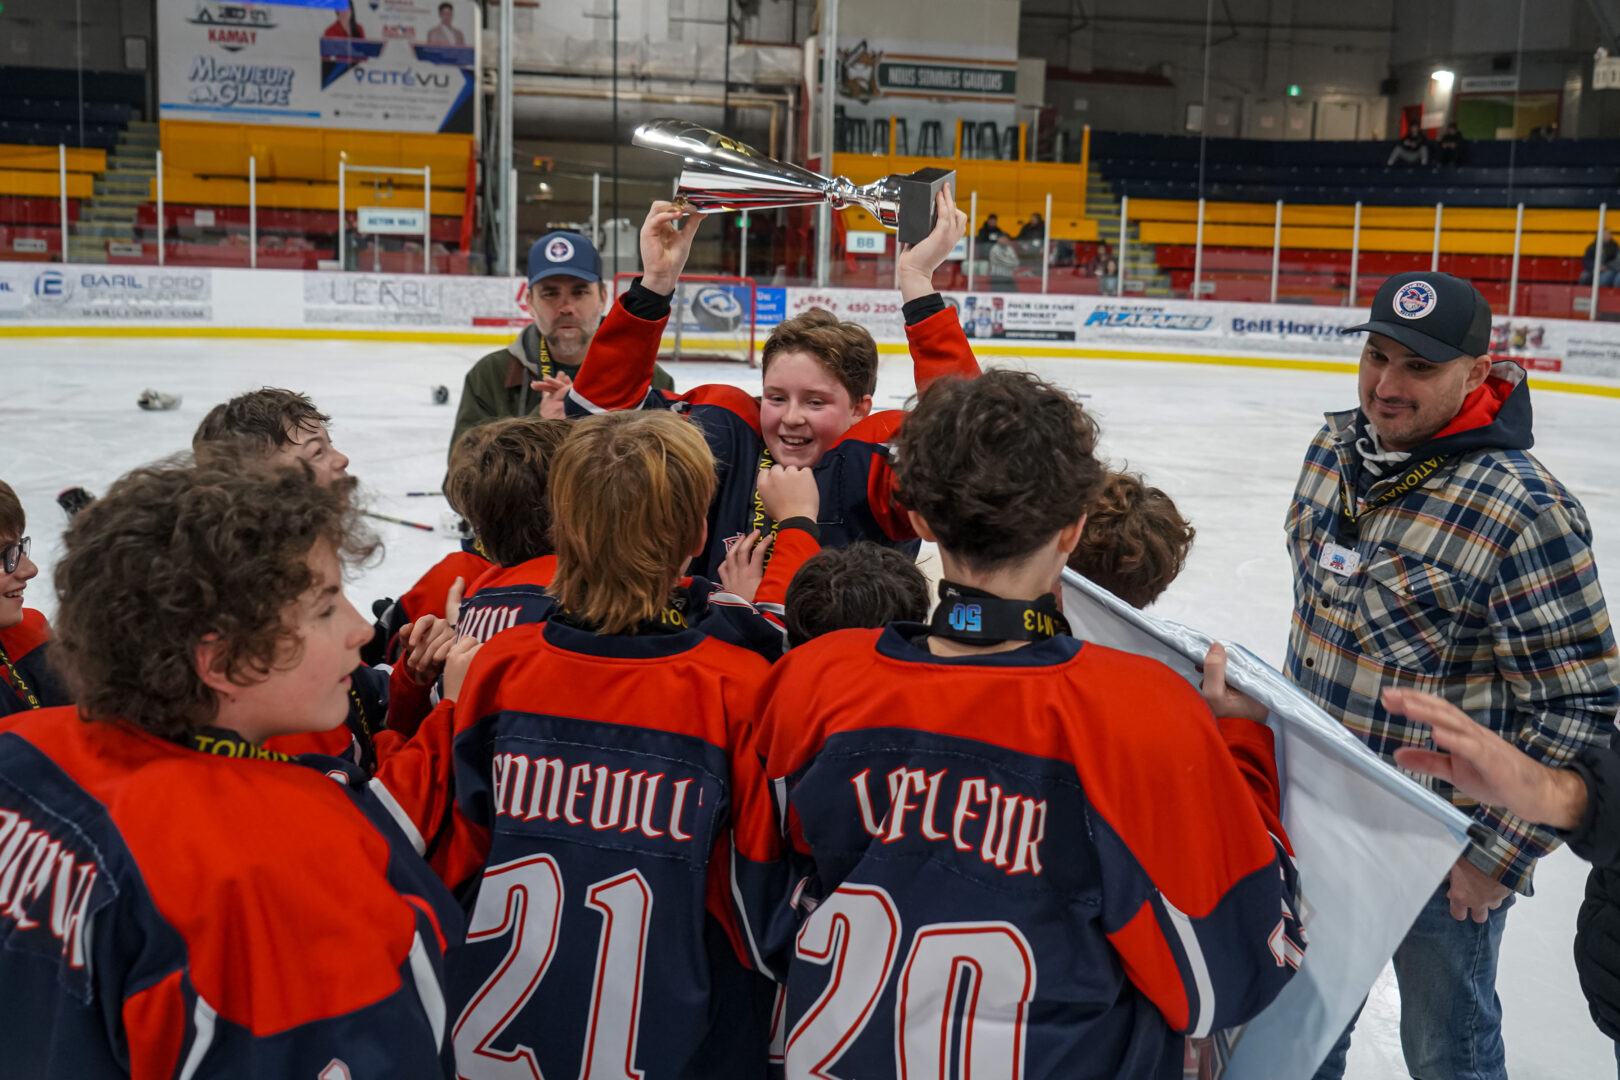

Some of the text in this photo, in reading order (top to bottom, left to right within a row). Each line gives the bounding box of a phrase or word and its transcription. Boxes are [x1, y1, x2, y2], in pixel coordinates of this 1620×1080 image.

[367, 67, 450, 88] CITÉVU
[888, 67, 1003, 90] NOUS SOMMES GAULOIS
[81, 274, 143, 289] BARIL
[1232, 318, 1272, 333] Bell
[451, 852, 655, 1080] 21
[783, 880, 1037, 1080] 20
